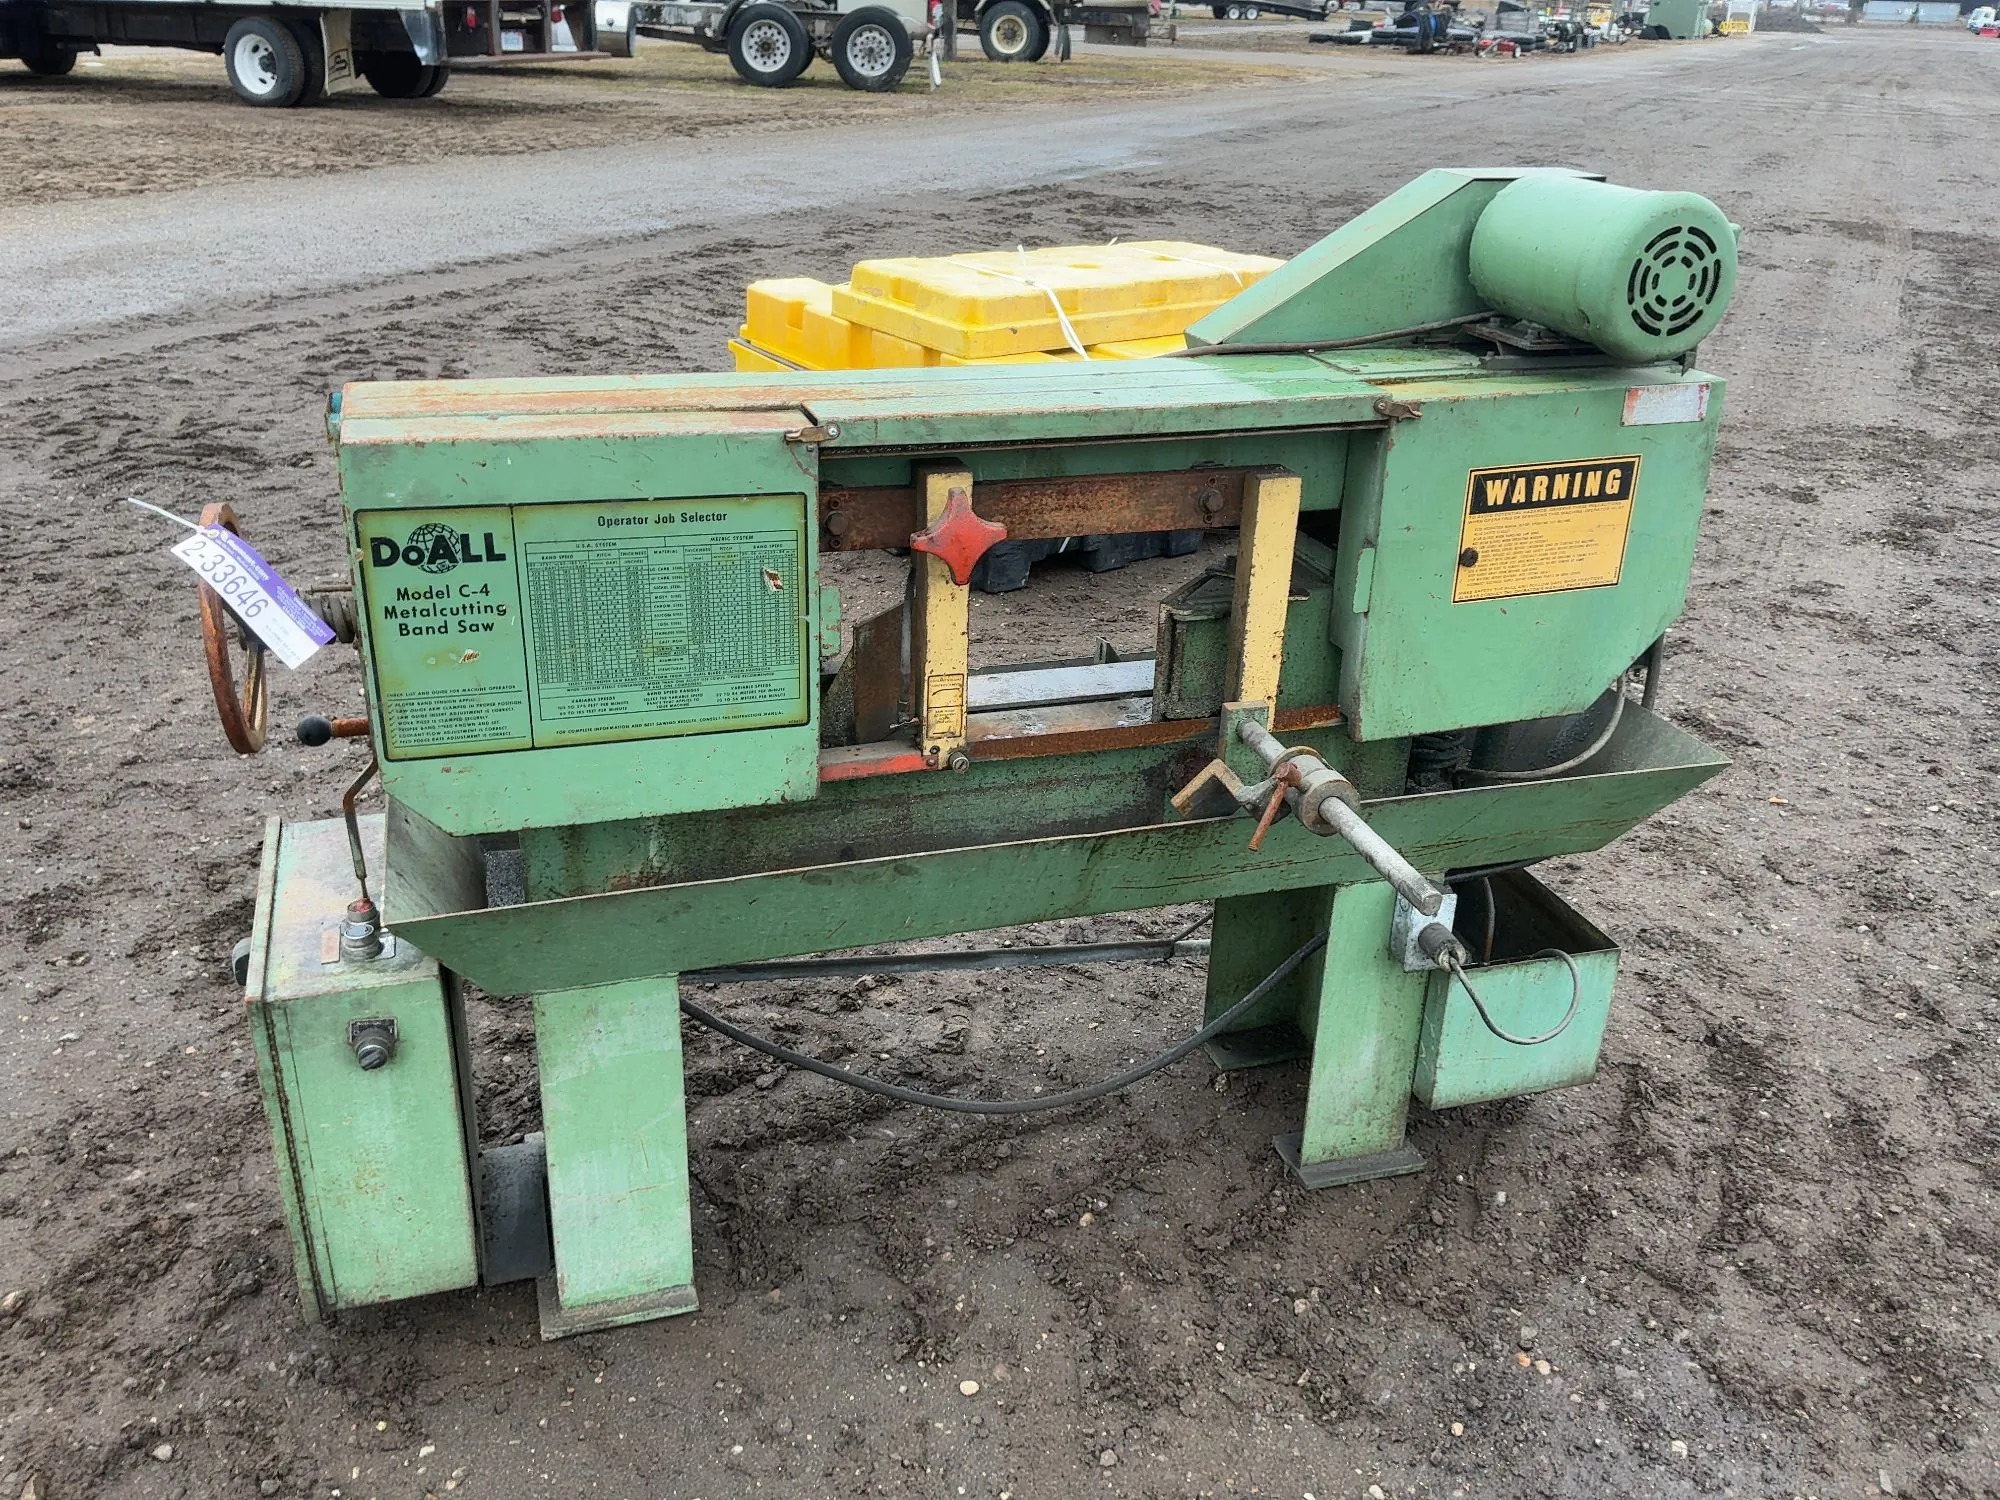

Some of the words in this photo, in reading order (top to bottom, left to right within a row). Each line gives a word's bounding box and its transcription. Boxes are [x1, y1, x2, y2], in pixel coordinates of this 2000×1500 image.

[1485, 468, 1622, 507] WARNING
[597, 515, 649, 528] Operator
[654, 512, 675, 524] Job
[681, 511, 727, 523] Selector
[370, 532, 507, 567] DoALL
[183, 541, 269, 618] 2-33646
[396, 584, 450, 600] Model
[458, 583, 491, 597] C-4
[384, 602, 507, 619] Metalcutting
[399, 620, 448, 636] Band
[458, 620, 495, 632] Saw
